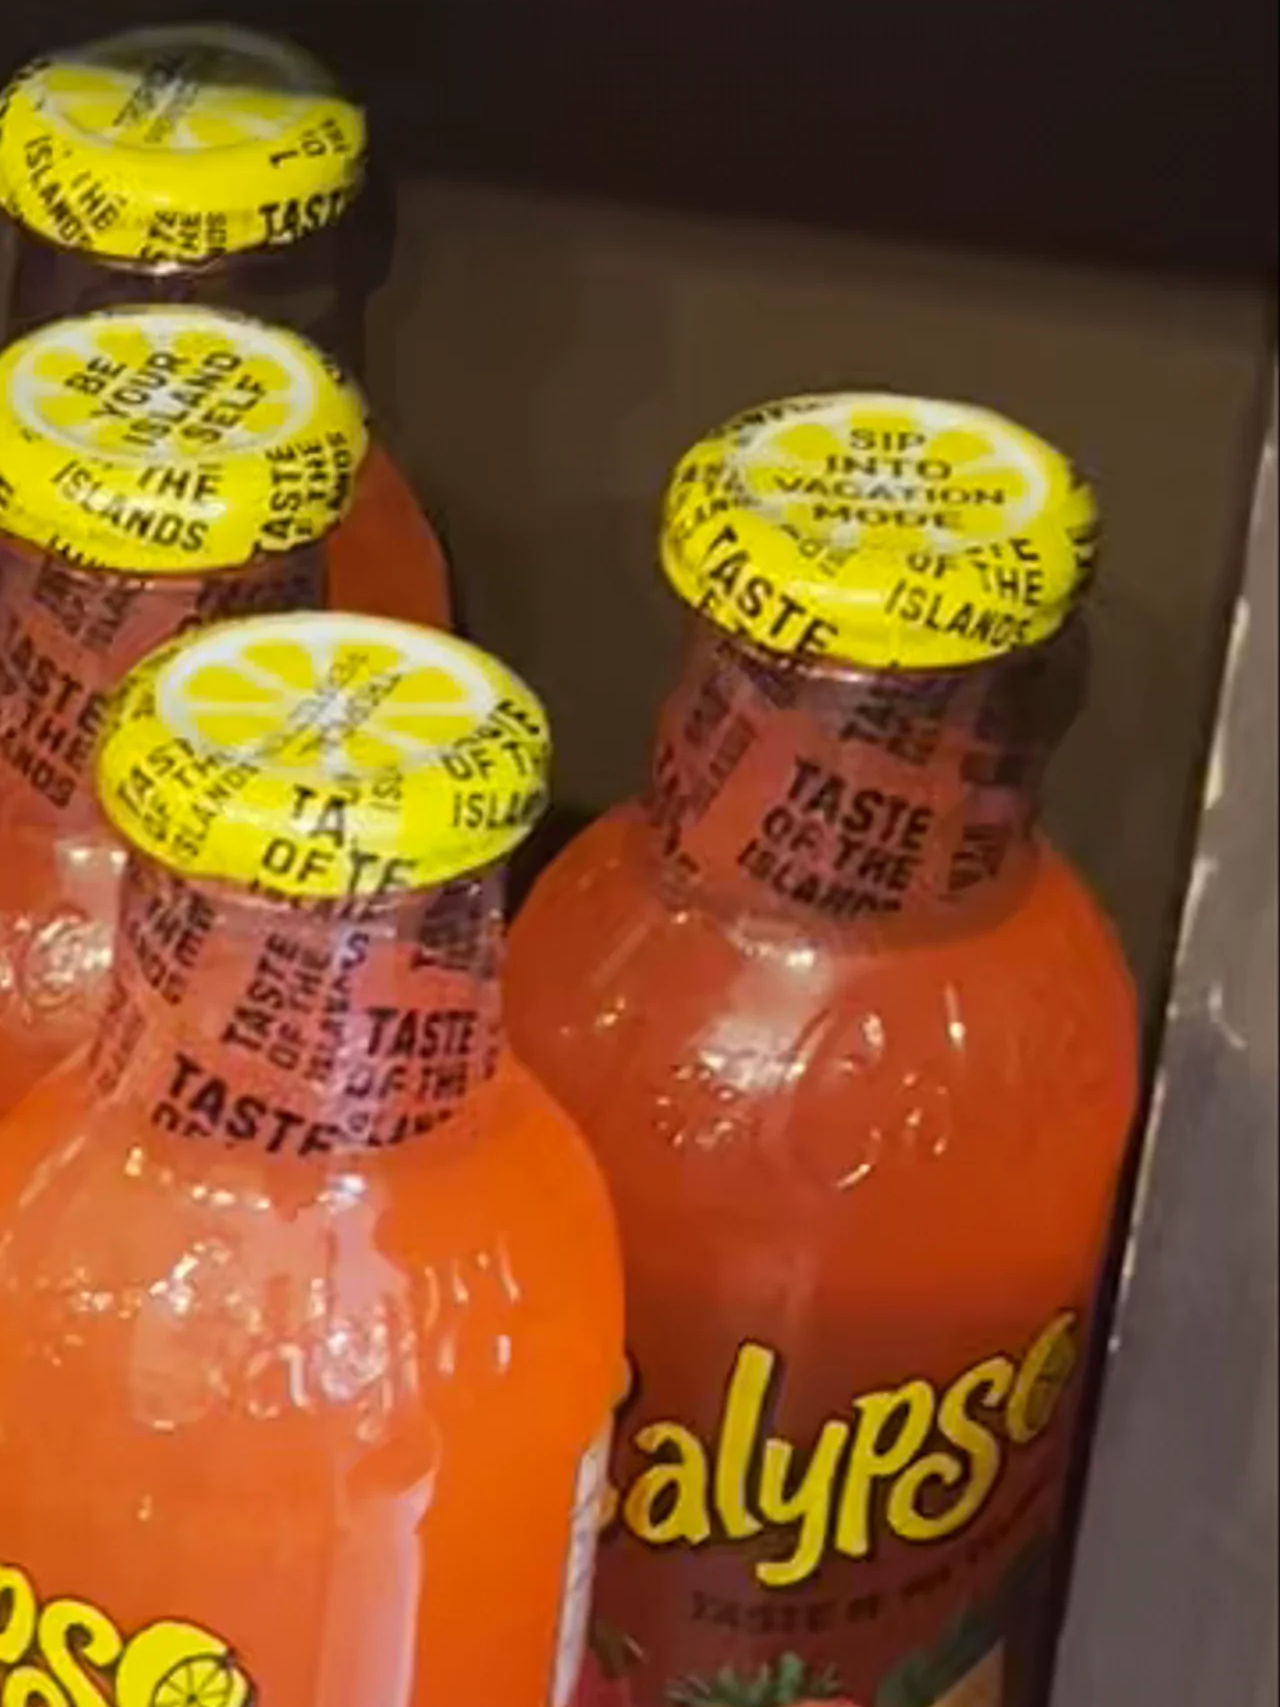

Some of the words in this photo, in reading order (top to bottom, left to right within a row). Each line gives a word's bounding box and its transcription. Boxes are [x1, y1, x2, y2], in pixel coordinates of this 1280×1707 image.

[65, 355, 128, 396] BE
[90, 350, 191, 422] YOUR
[122, 348, 244, 449] ISLAND
[825, 455, 954, 480] INTO
[848, 428, 926, 453] SIP
[50, 459, 210, 554] ISLANDS
[774, 475, 1007, 506] VACATION
[811, 503, 966, 529] MODE
[708, 526, 840, 654] TASTE
[788, 754, 937, 852] TASTE
[838, 837, 925, 891] THE
[364, 1006, 479, 1061] TASTE
[170, 1051, 342, 1157] TASTE
[623, 1309, 1078, 1590] alypso
